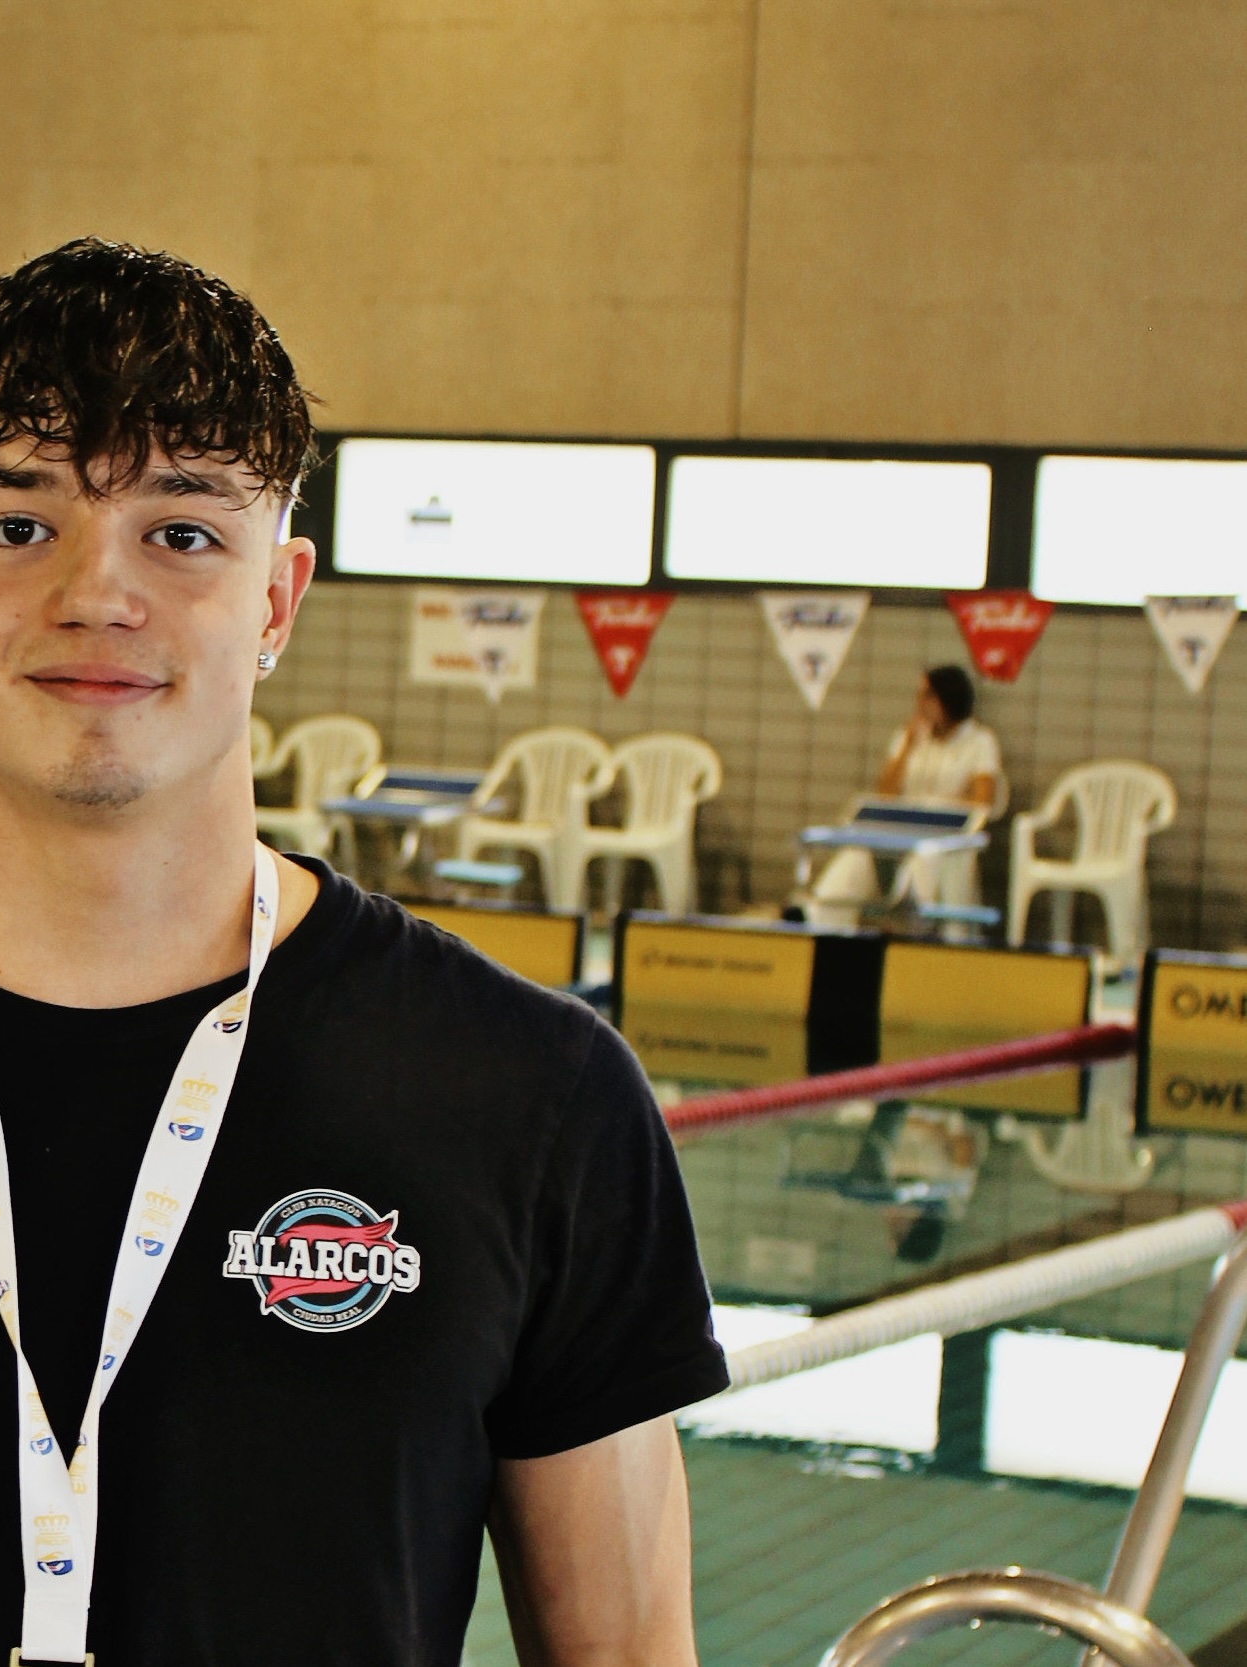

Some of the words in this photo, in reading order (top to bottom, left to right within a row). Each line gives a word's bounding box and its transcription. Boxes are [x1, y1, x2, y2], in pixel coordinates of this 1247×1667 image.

[280, 1201, 307, 1218] CLUB
[227, 1233, 420, 1289] ALARCOS
[293, 1308, 335, 1323] CIUDAD
[335, 1307, 363, 1322] REAL
